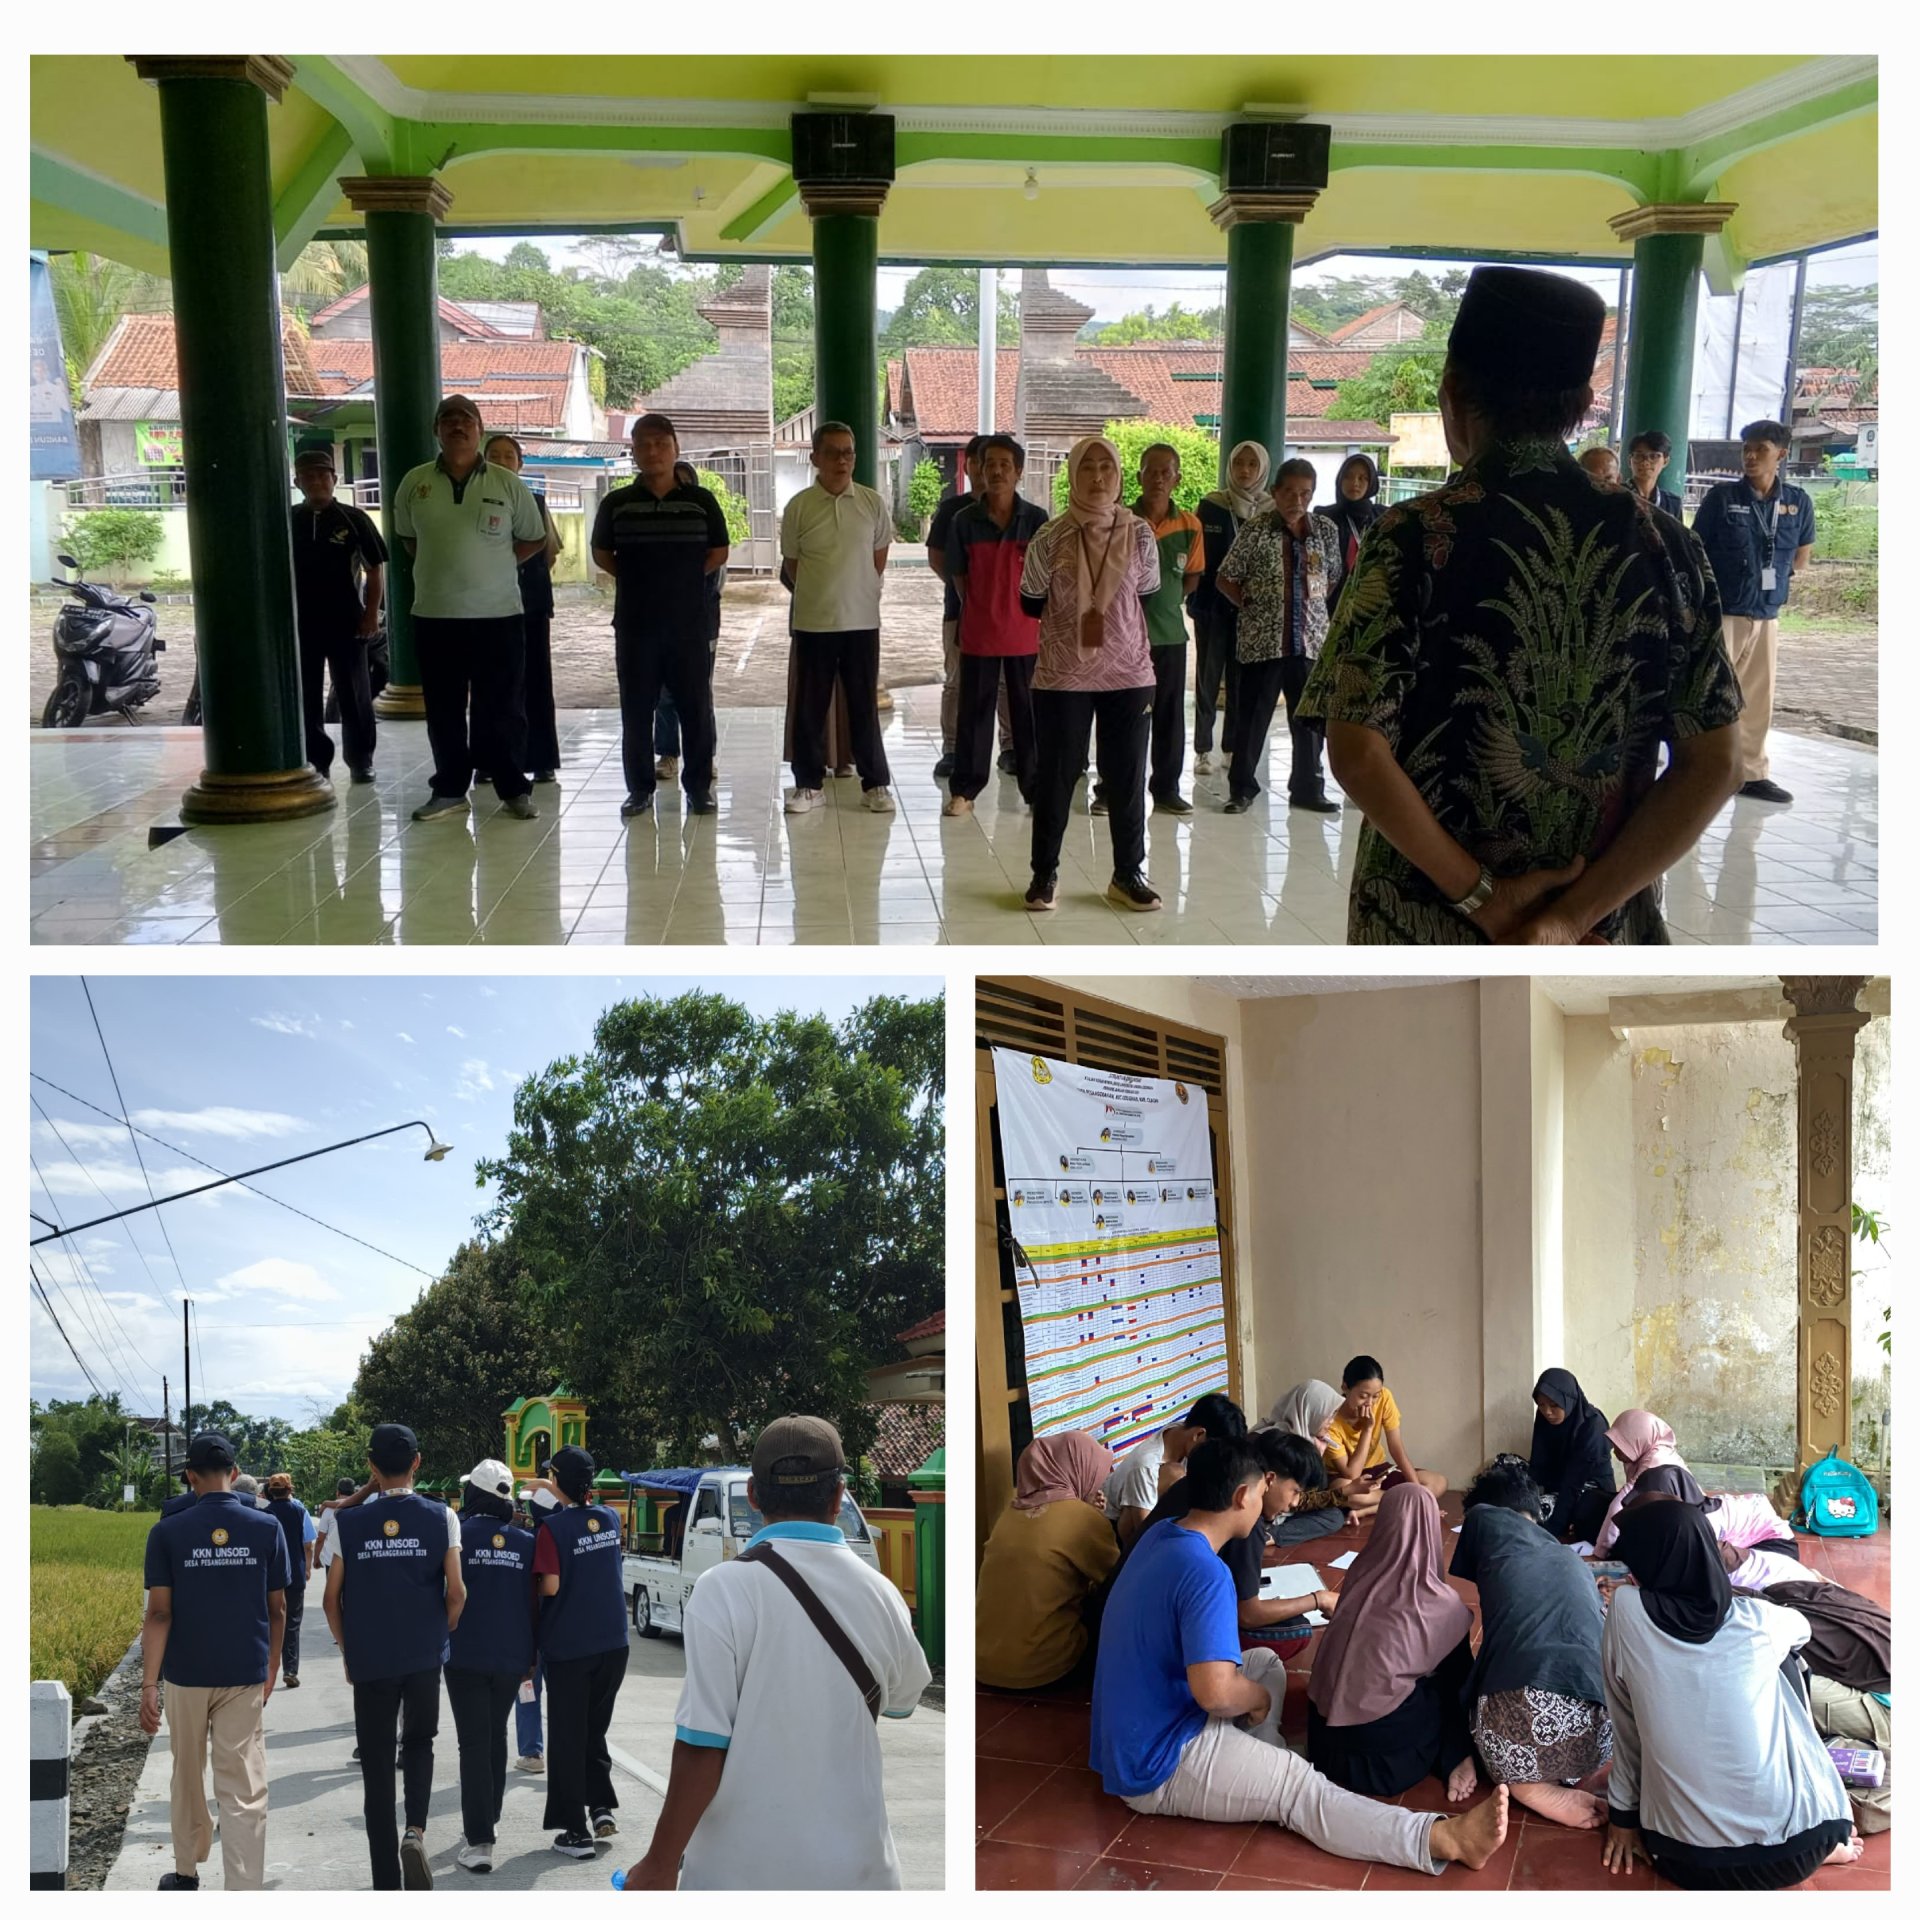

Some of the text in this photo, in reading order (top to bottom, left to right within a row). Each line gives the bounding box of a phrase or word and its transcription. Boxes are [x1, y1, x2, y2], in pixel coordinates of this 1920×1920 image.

[364, 1538, 420, 1550] KKN UNSOED
[577, 1536, 593, 1547] KKN
[593, 1529, 617, 1543] UNSOED
[192, 1547, 250, 1559] KKN UNSOED
[357, 1552, 371, 1560] DESA
[372, 1549, 413, 1558] PESANGGRAHAN
[475, 1549, 520, 1561] KKN UNSOED
[184, 1559, 199, 1567] DESA
[201, 1558, 244, 1567] PESANGGRAHAN
